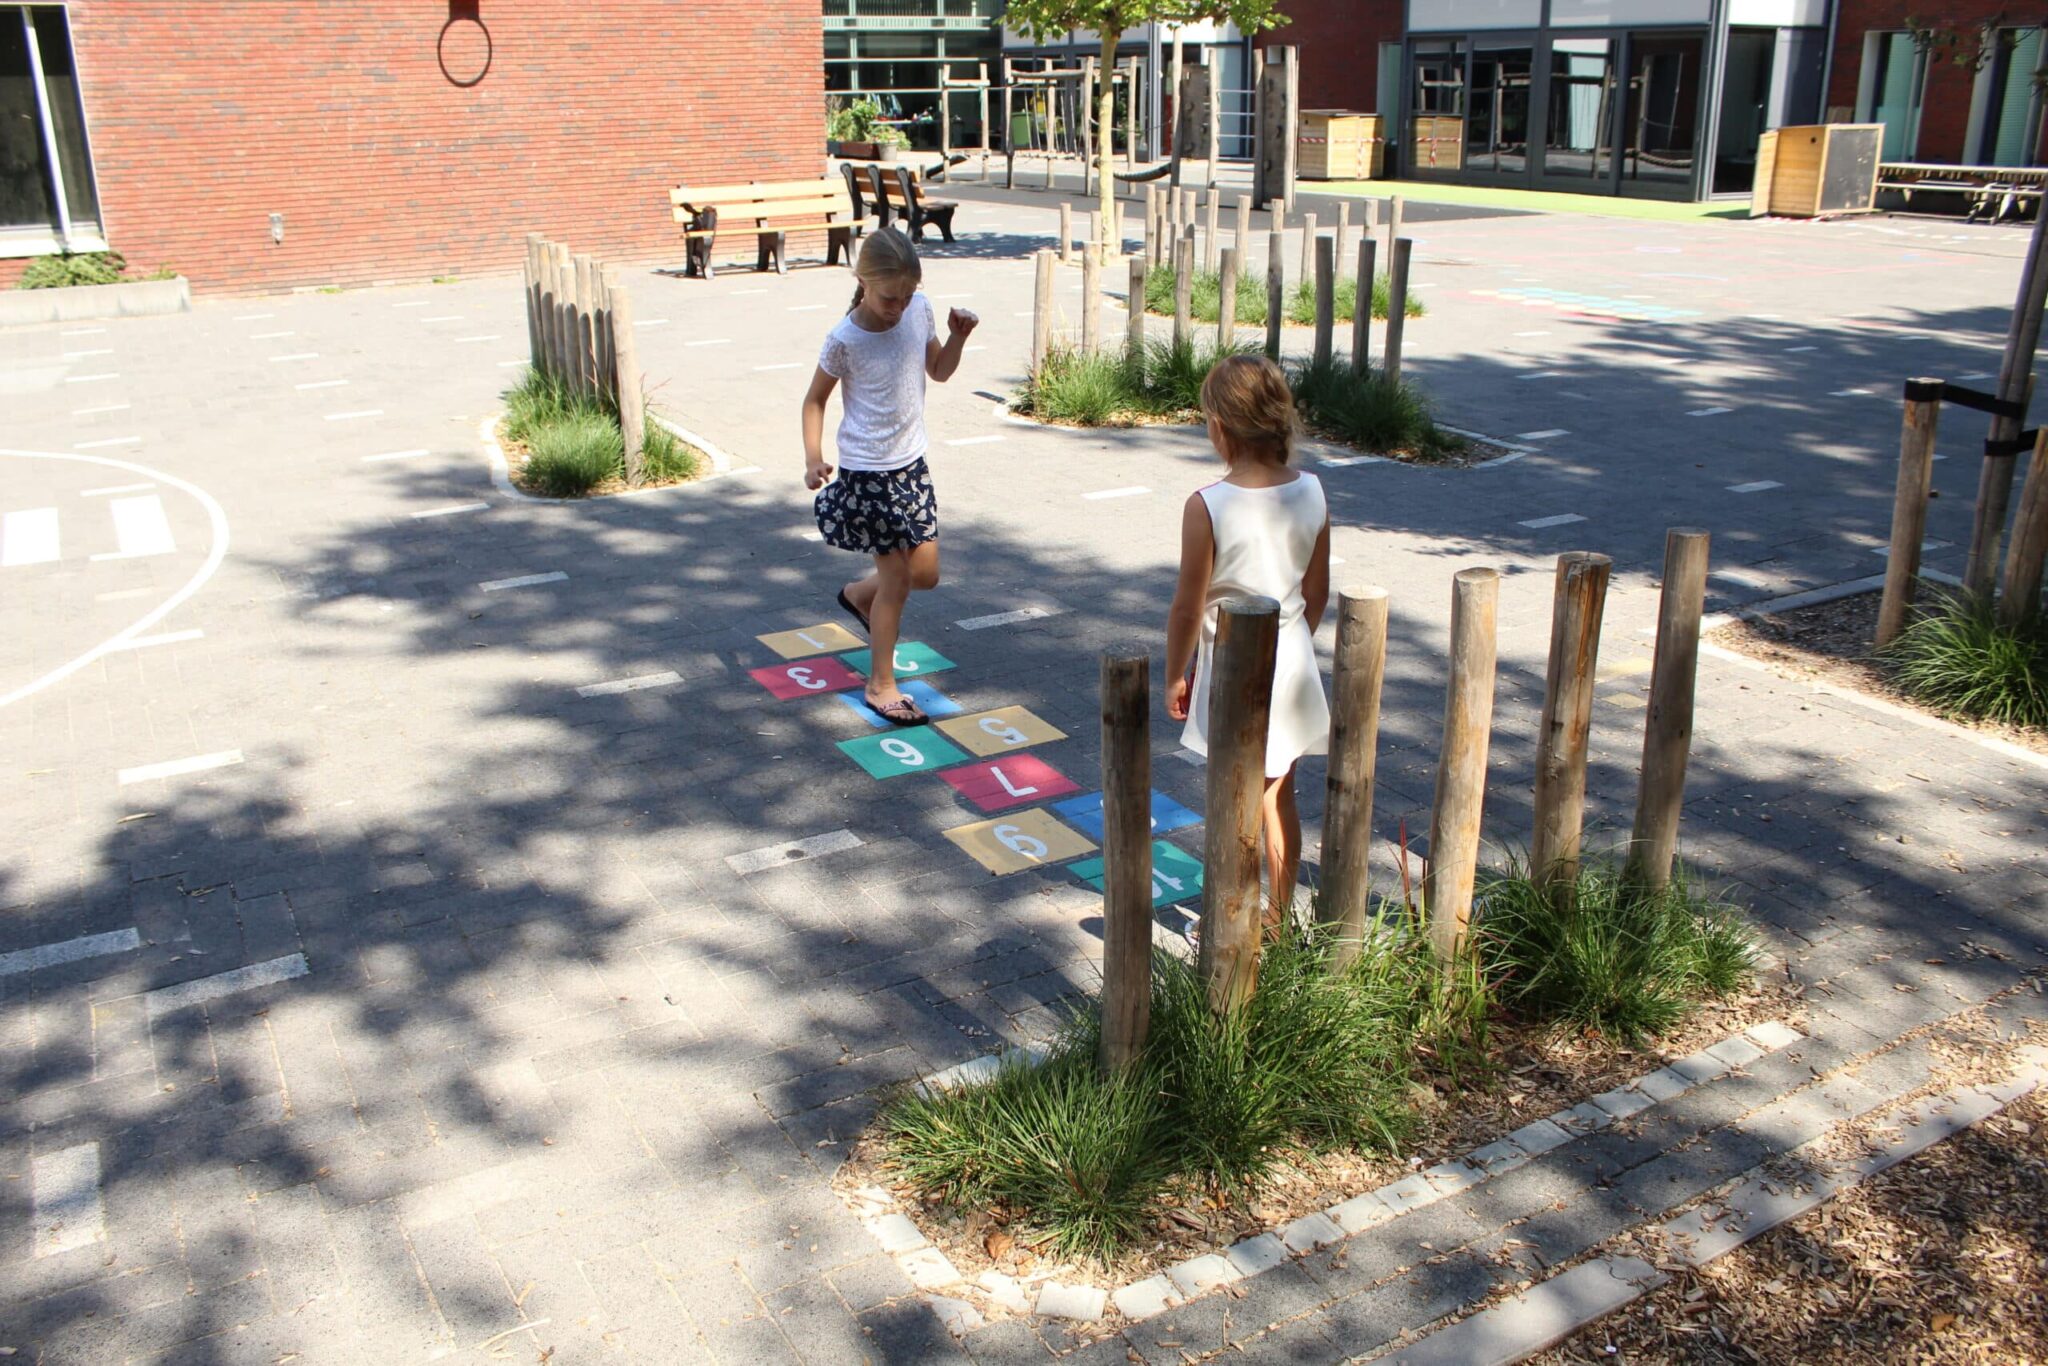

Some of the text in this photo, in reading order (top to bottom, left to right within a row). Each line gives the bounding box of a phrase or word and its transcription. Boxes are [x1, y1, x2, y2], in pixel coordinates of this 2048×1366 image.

[797, 632, 826, 649] 1
[786, 667, 827, 689] 3
[978, 717, 1029, 745] 5
[879, 738, 925, 766] 6
[990, 766, 1038, 797] 7
